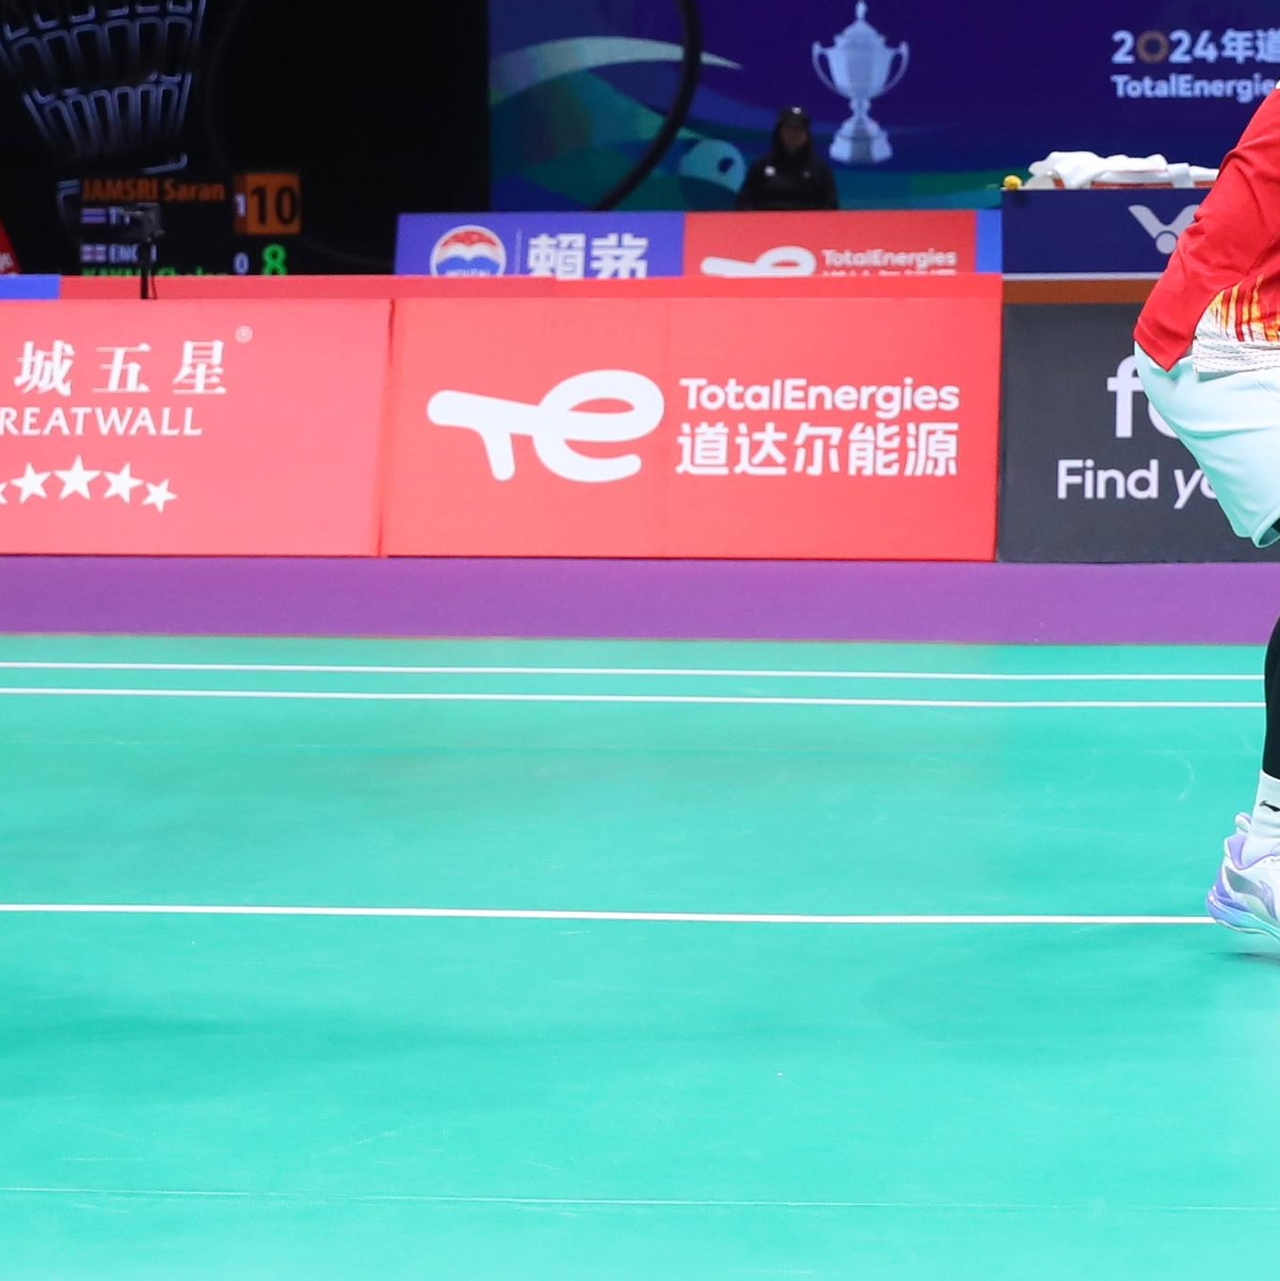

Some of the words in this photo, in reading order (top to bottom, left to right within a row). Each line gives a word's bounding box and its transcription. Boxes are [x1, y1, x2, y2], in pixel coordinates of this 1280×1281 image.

[1111, 74, 1274, 103] TotalEnergie
[163, 179, 225, 202] Saran
[235, 193, 246, 218] 1
[250, 185, 298, 225] 10
[262, 244, 287, 276] 8
[822, 248, 958, 270] TotalEnergies
[679, 377, 960, 419] TotalEnergies
[676, 422, 959, 478] 道达尔能源
[1057, 458, 1160, 499] Find
